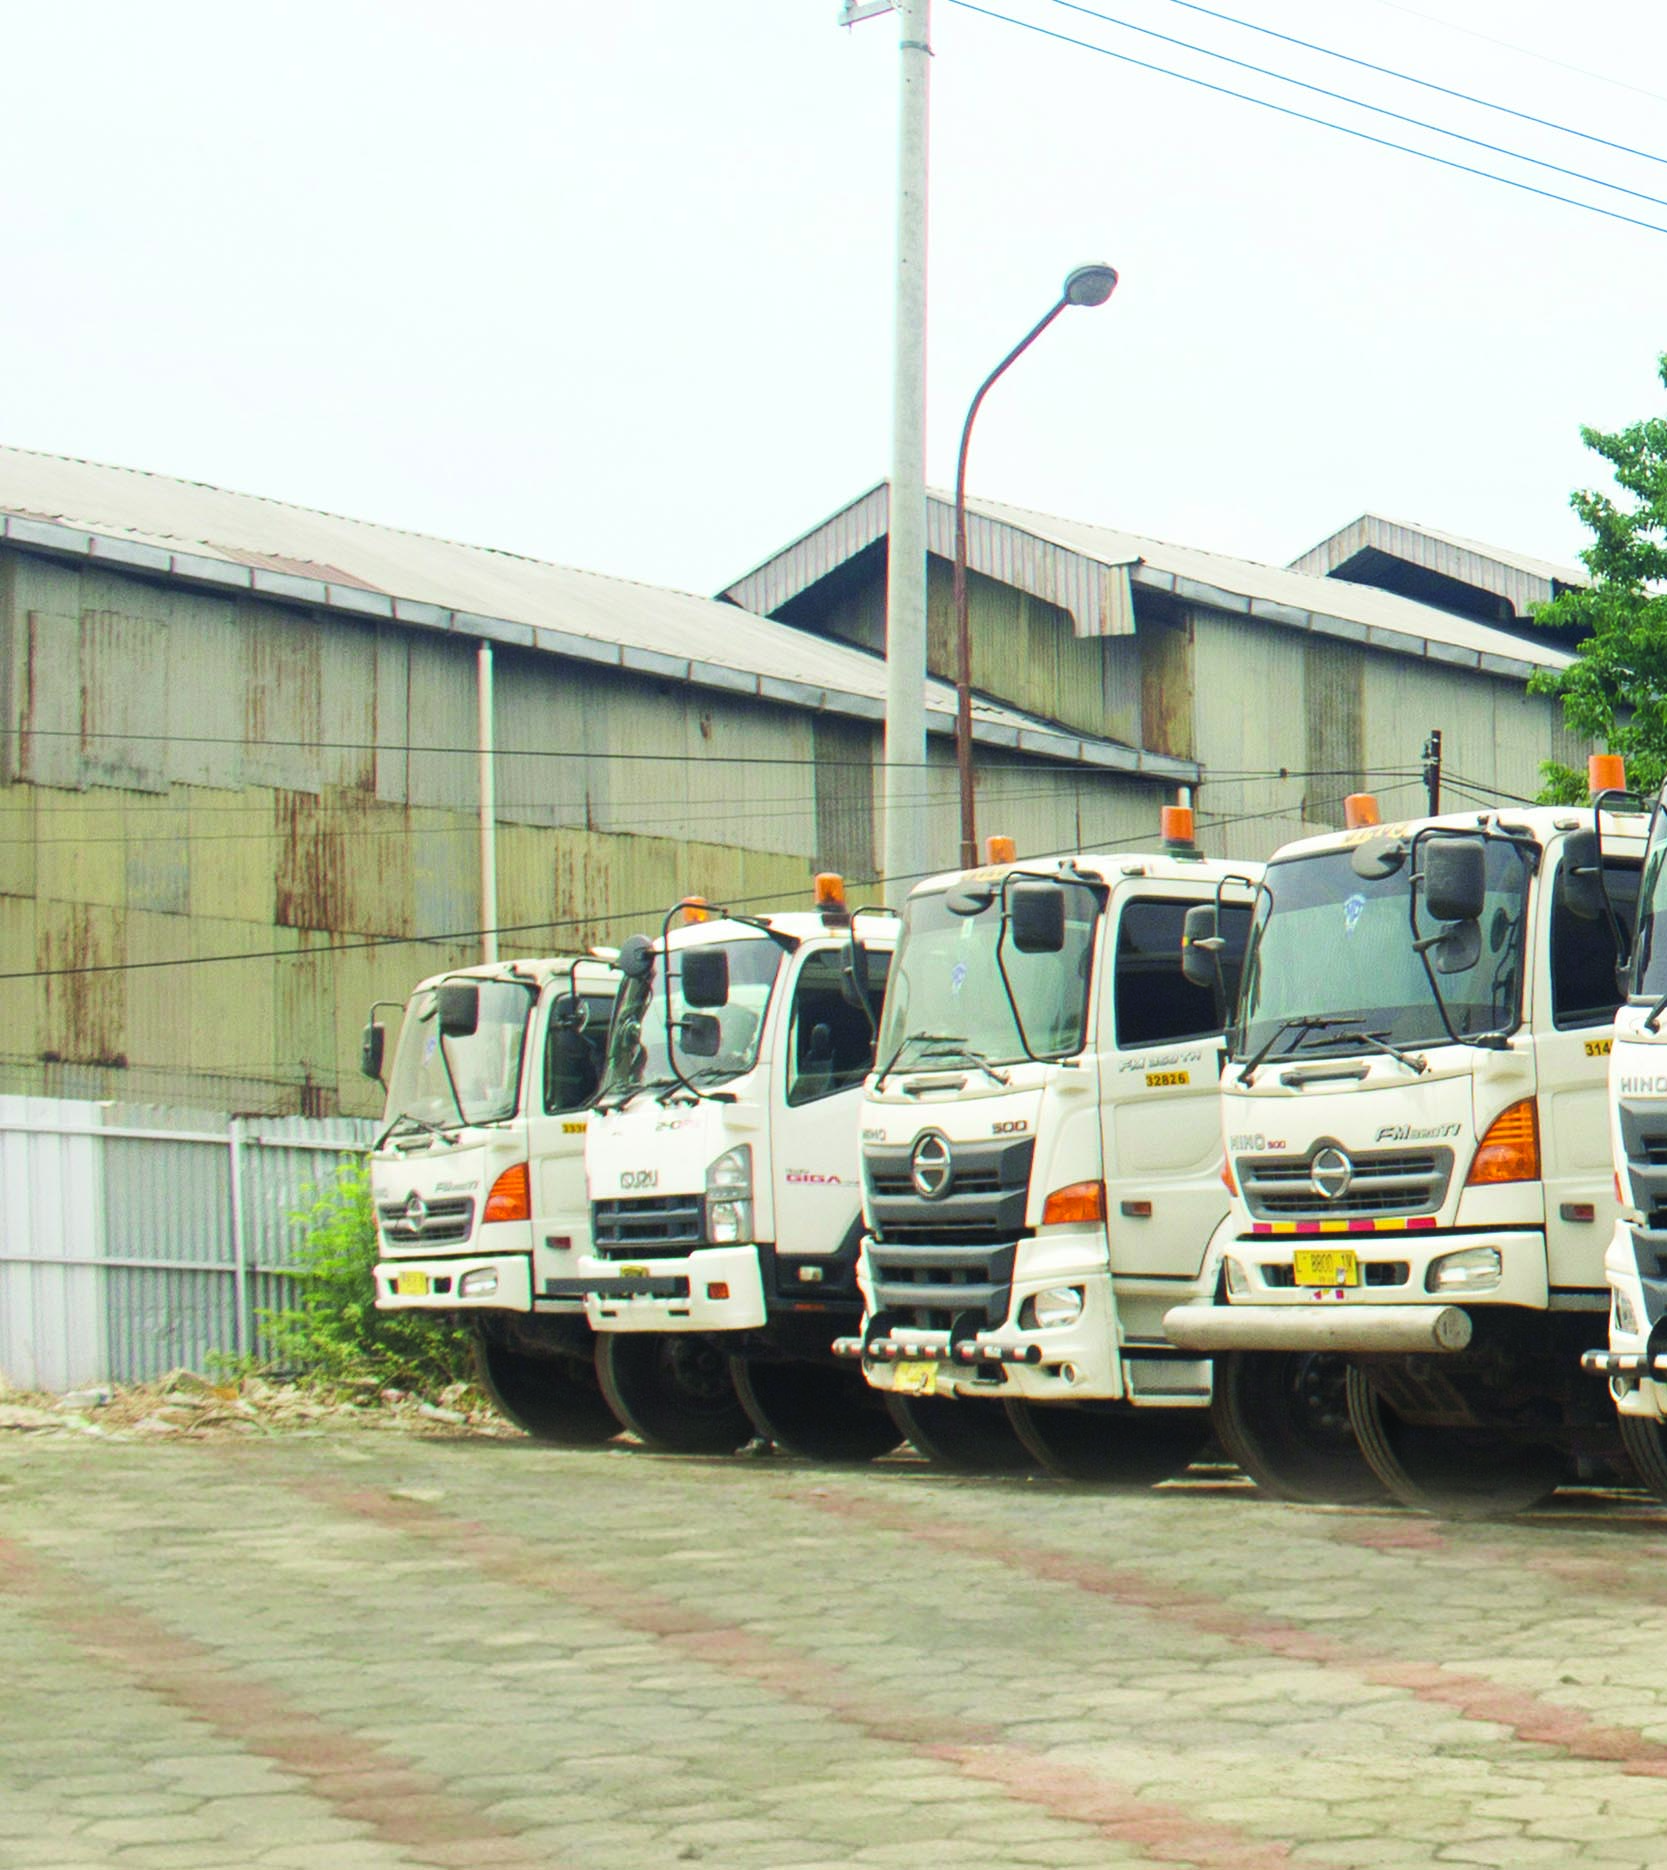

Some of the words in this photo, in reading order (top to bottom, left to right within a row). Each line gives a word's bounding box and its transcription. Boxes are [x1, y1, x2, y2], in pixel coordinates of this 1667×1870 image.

[1146, 1073, 1186, 1087] 32826
[992, 1120, 1028, 1134] 500
[786, 1173, 841, 1184] GIGA
